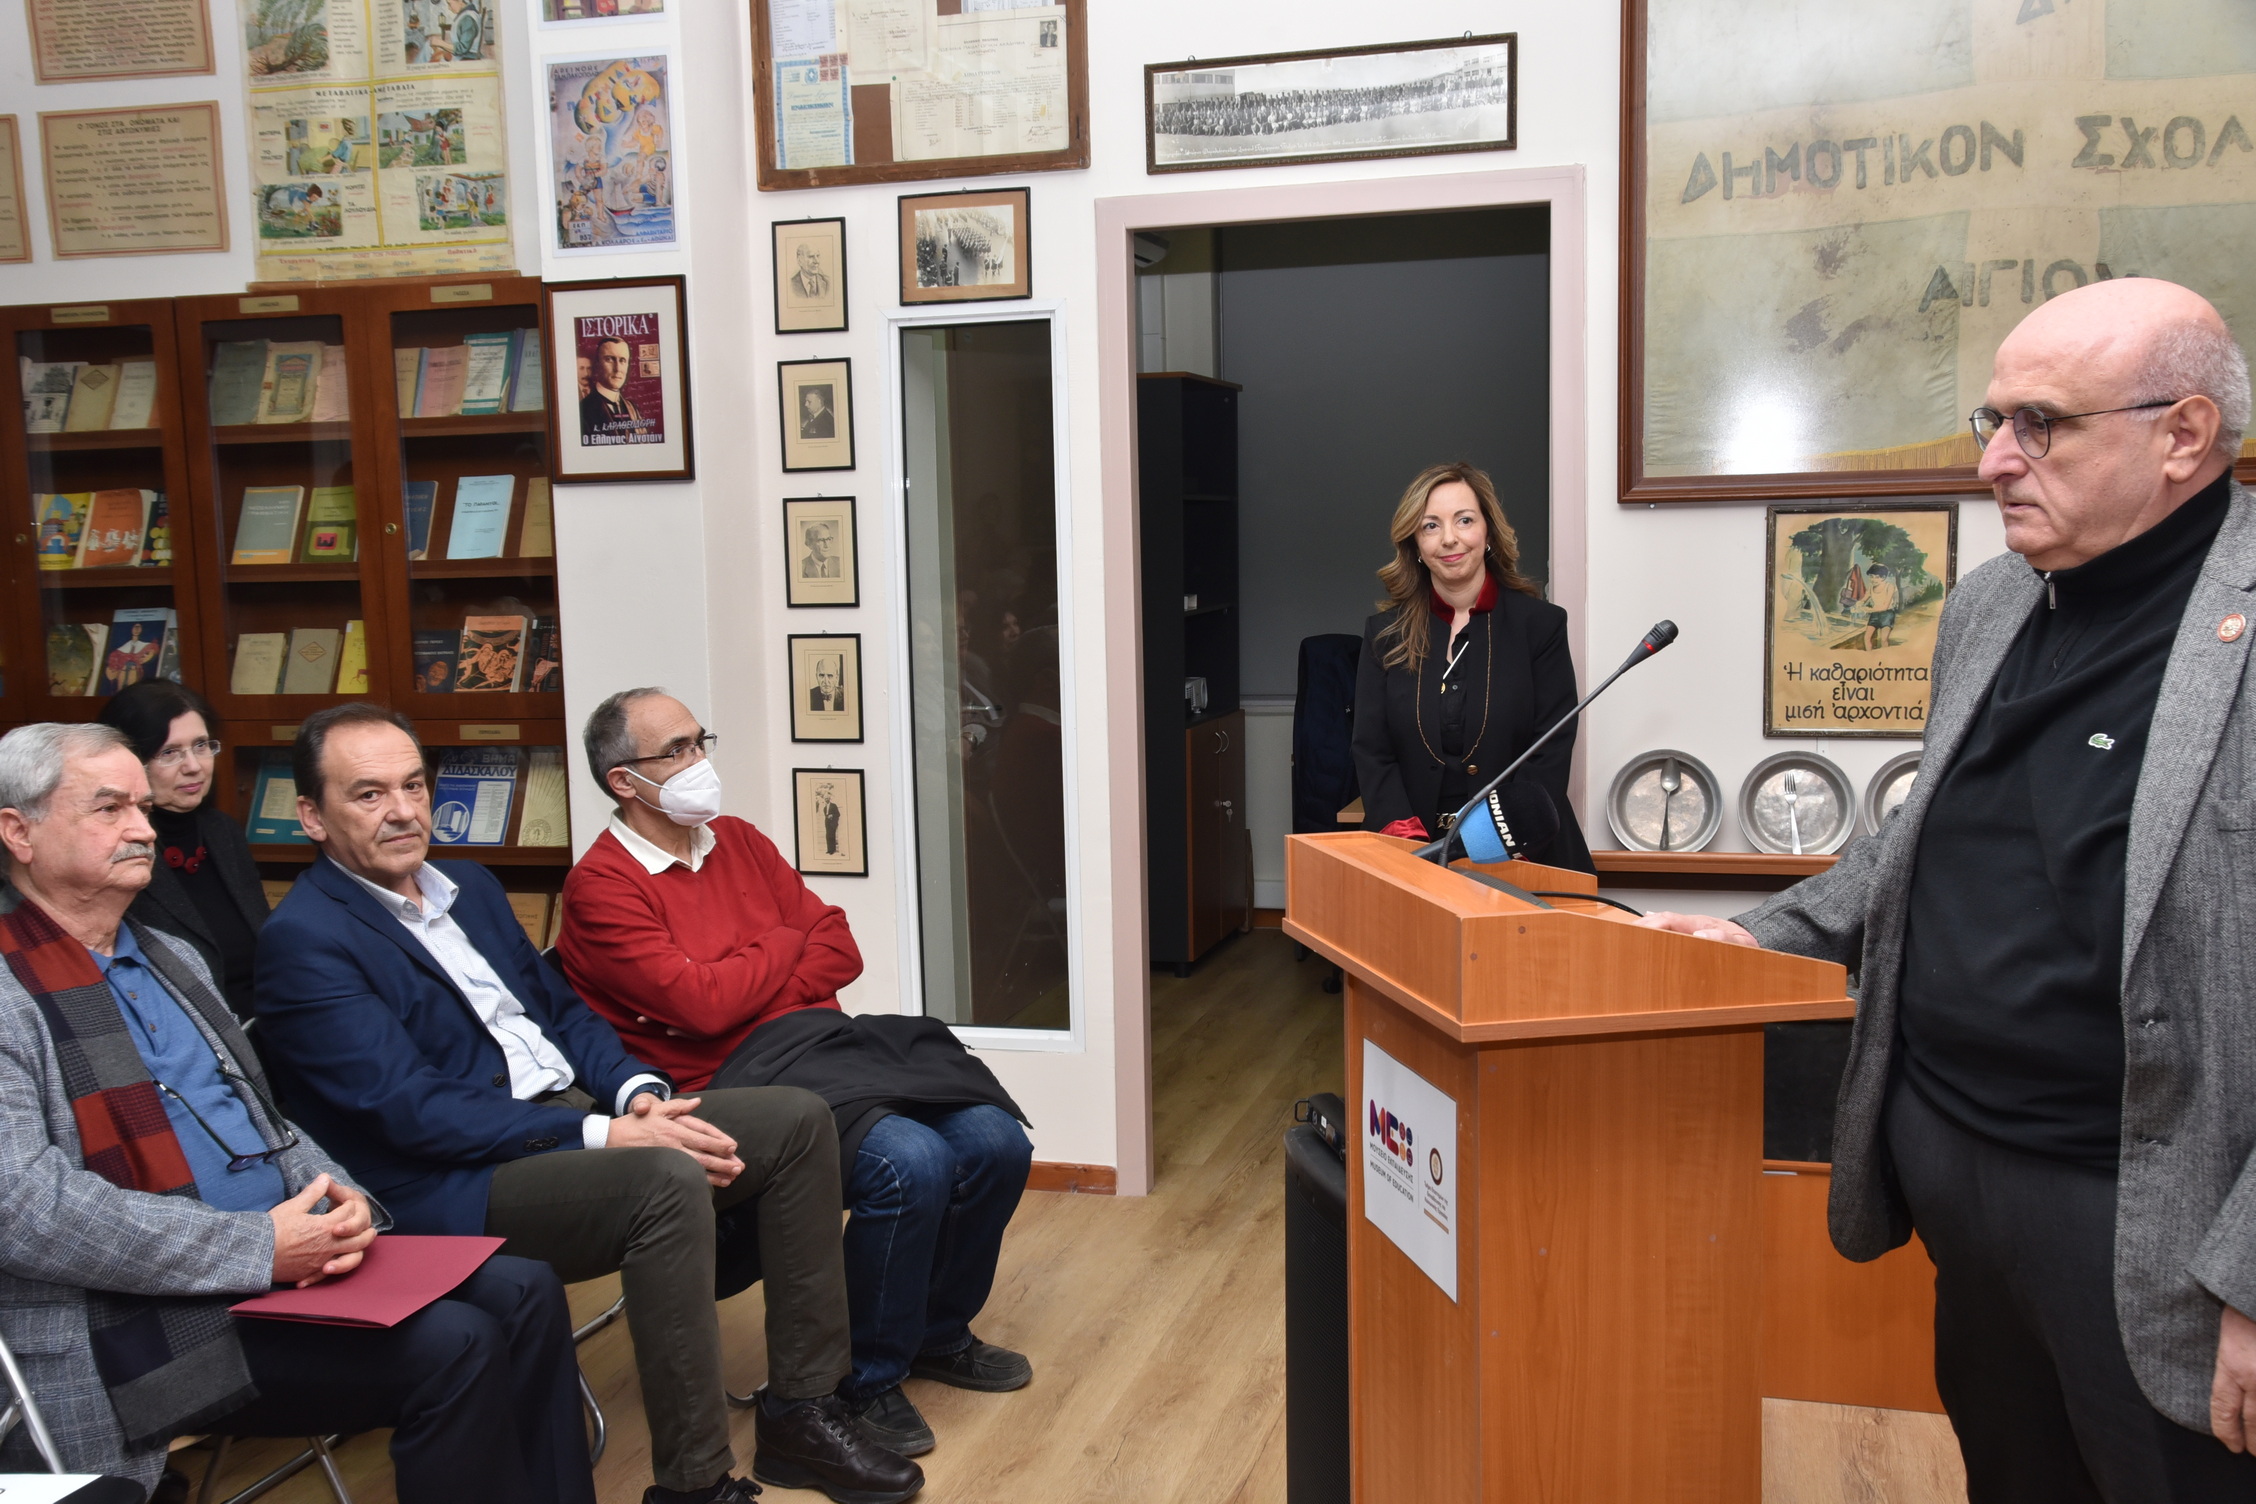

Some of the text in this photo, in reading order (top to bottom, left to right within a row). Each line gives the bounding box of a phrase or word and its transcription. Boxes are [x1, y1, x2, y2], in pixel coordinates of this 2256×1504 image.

[1680, 119, 2024, 204] ΔΗΜΟΤΙΚΟΝ
[581, 314, 650, 338] ΙΣΤΟΡΙΚΑ
[582, 434, 590, 445] Ο
[1810, 661, 1928, 682] καθαριότητα
[1785, 699, 1824, 722] μισή
[481, 753, 516, 764] ΒΗΜΑ
[442, 764, 517, 777] ΔΙΔΑΣΚΑΛΟΥ
[1370, 1142, 1413, 1184] ΜΟΥΣΕΙΟ ΕΚΠΑΙΔΕΥΣΗΣ
[1370, 1160, 1386, 1178] MUSEUM
[1387, 1173, 1392, 1183] OF
[1392, 1178, 1414, 1203] EDUCATION
